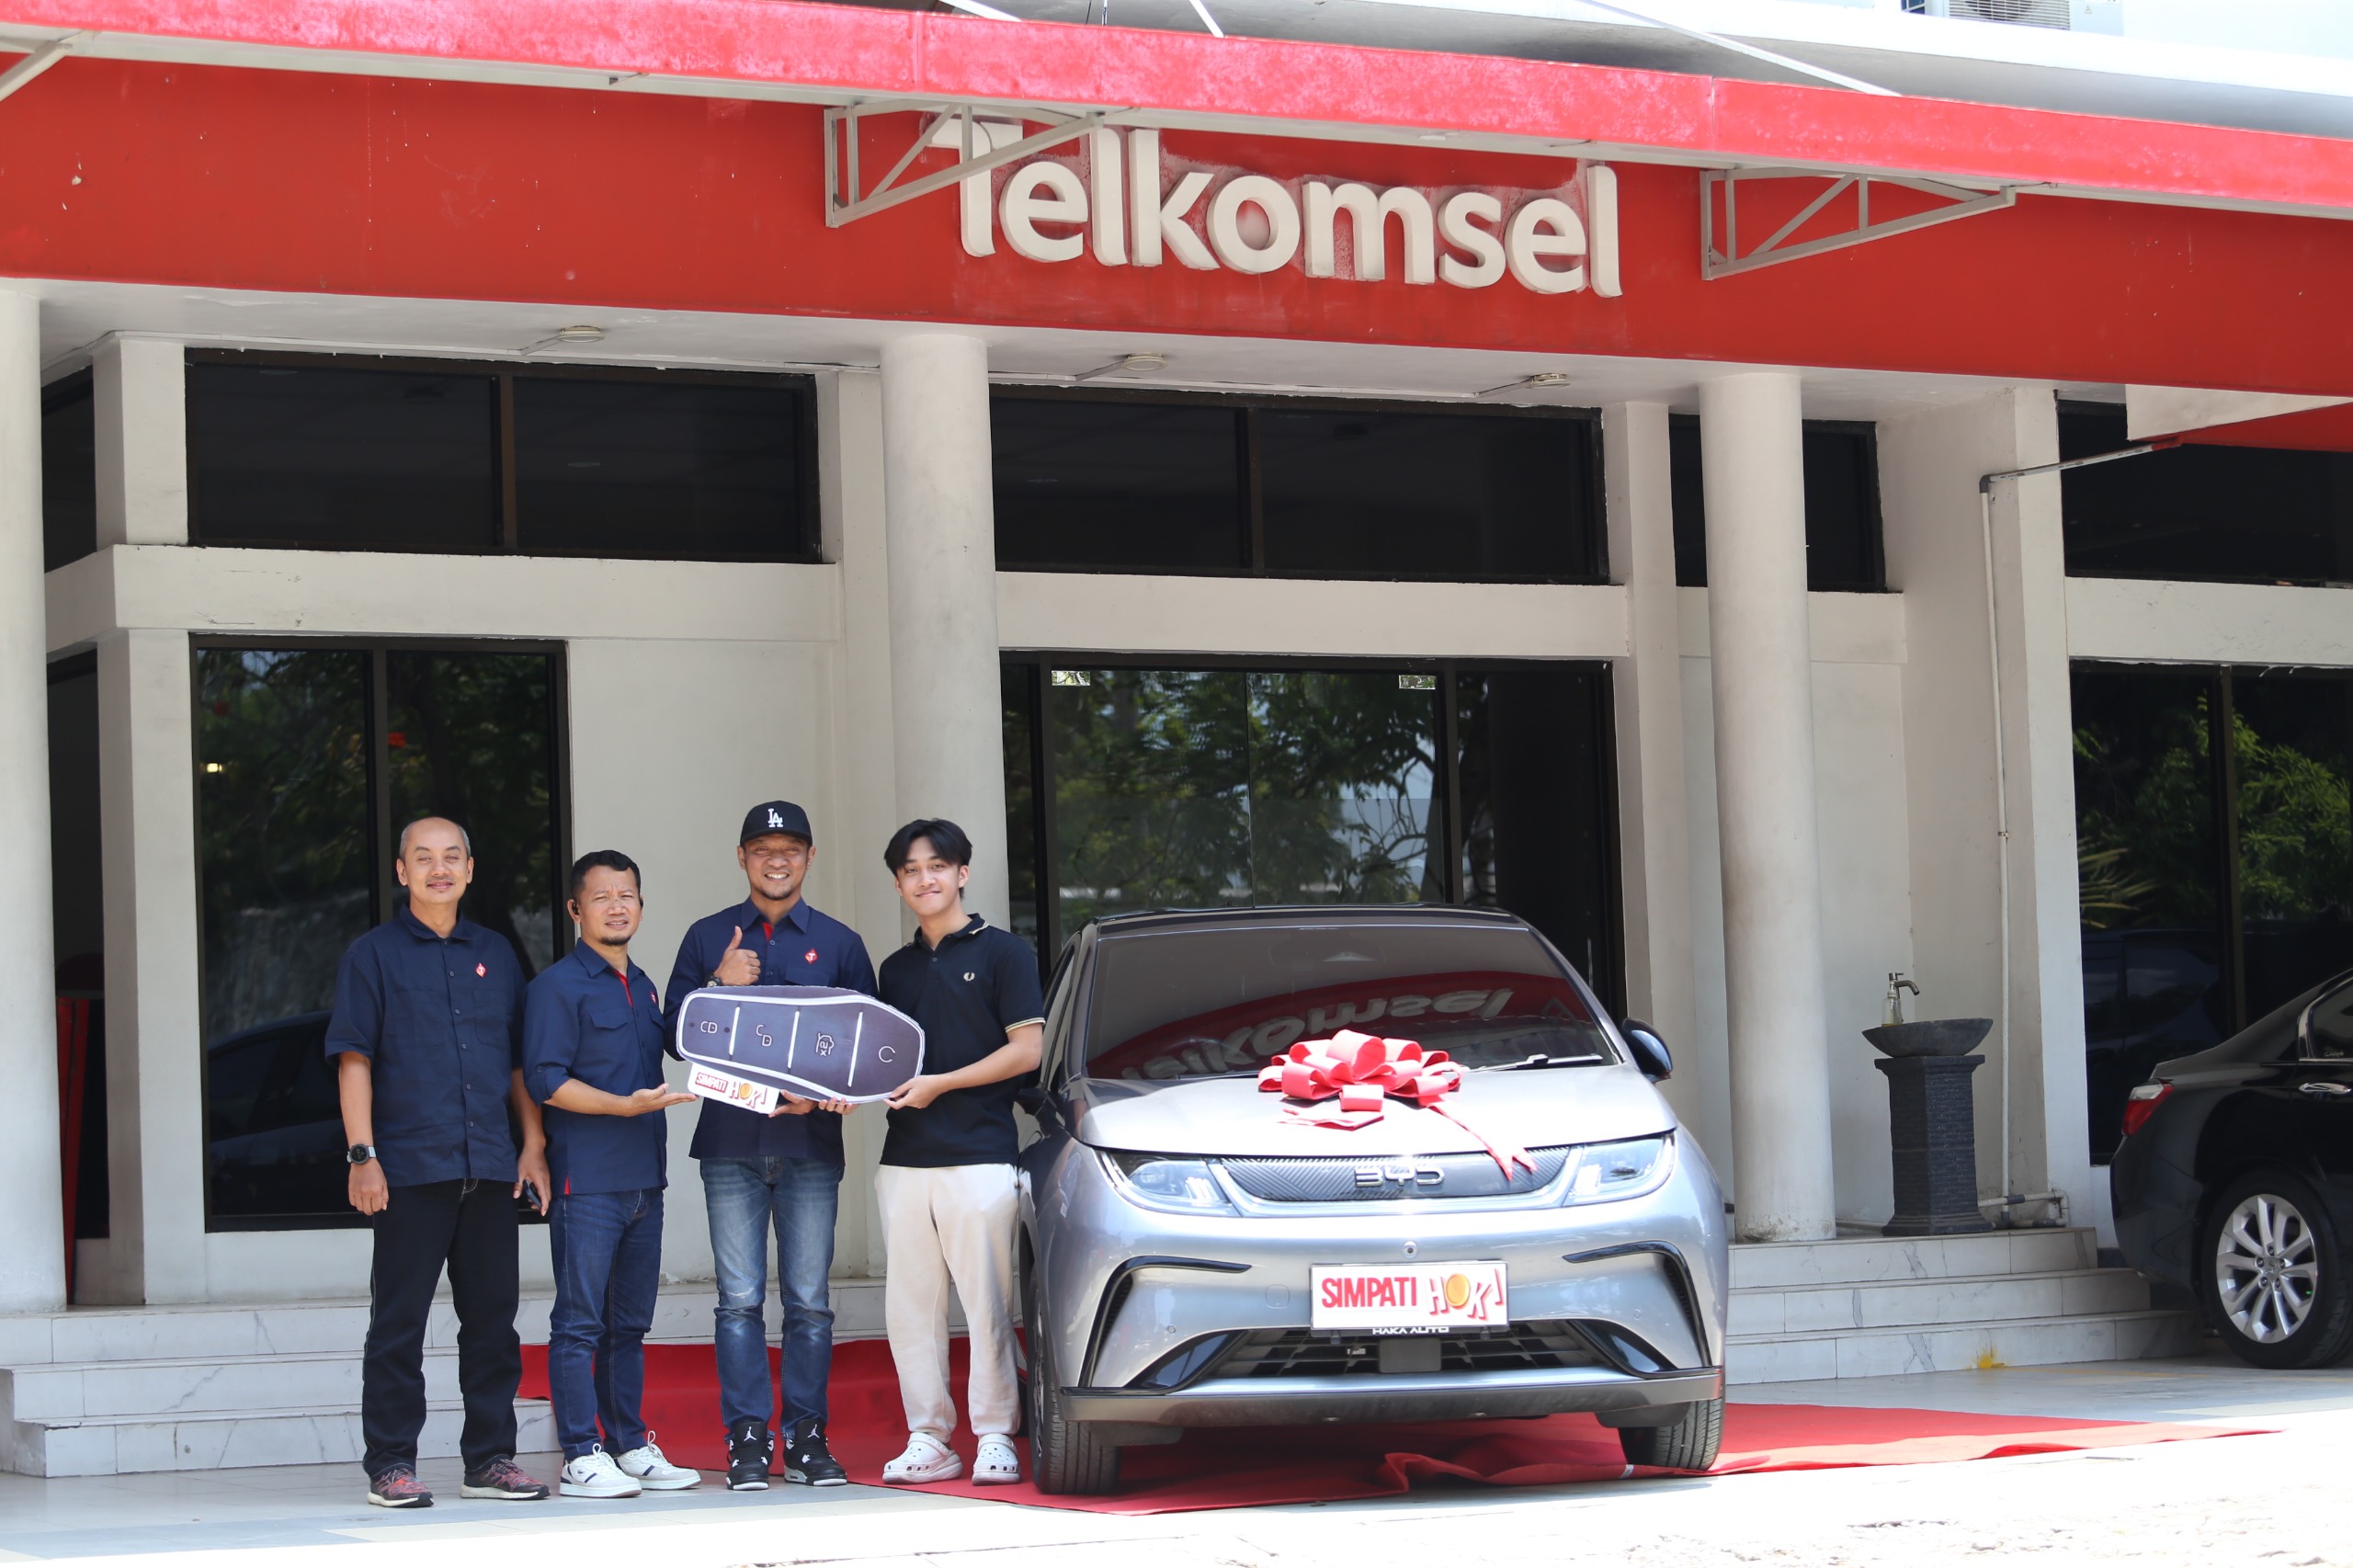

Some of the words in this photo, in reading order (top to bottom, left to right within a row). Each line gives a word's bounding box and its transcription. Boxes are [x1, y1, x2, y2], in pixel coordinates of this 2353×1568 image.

[925, 116, 1622, 298] Telkomsel
[767, 808, 784, 828] LA
[695, 1072, 728, 1093] SIMPATI
[729, 1080, 768, 1108] HOKI
[1321, 1277, 1417, 1309] SIMPATI
[1427, 1267, 1505, 1321] HOKI
[1372, 1327, 1408, 1335] HAKA
